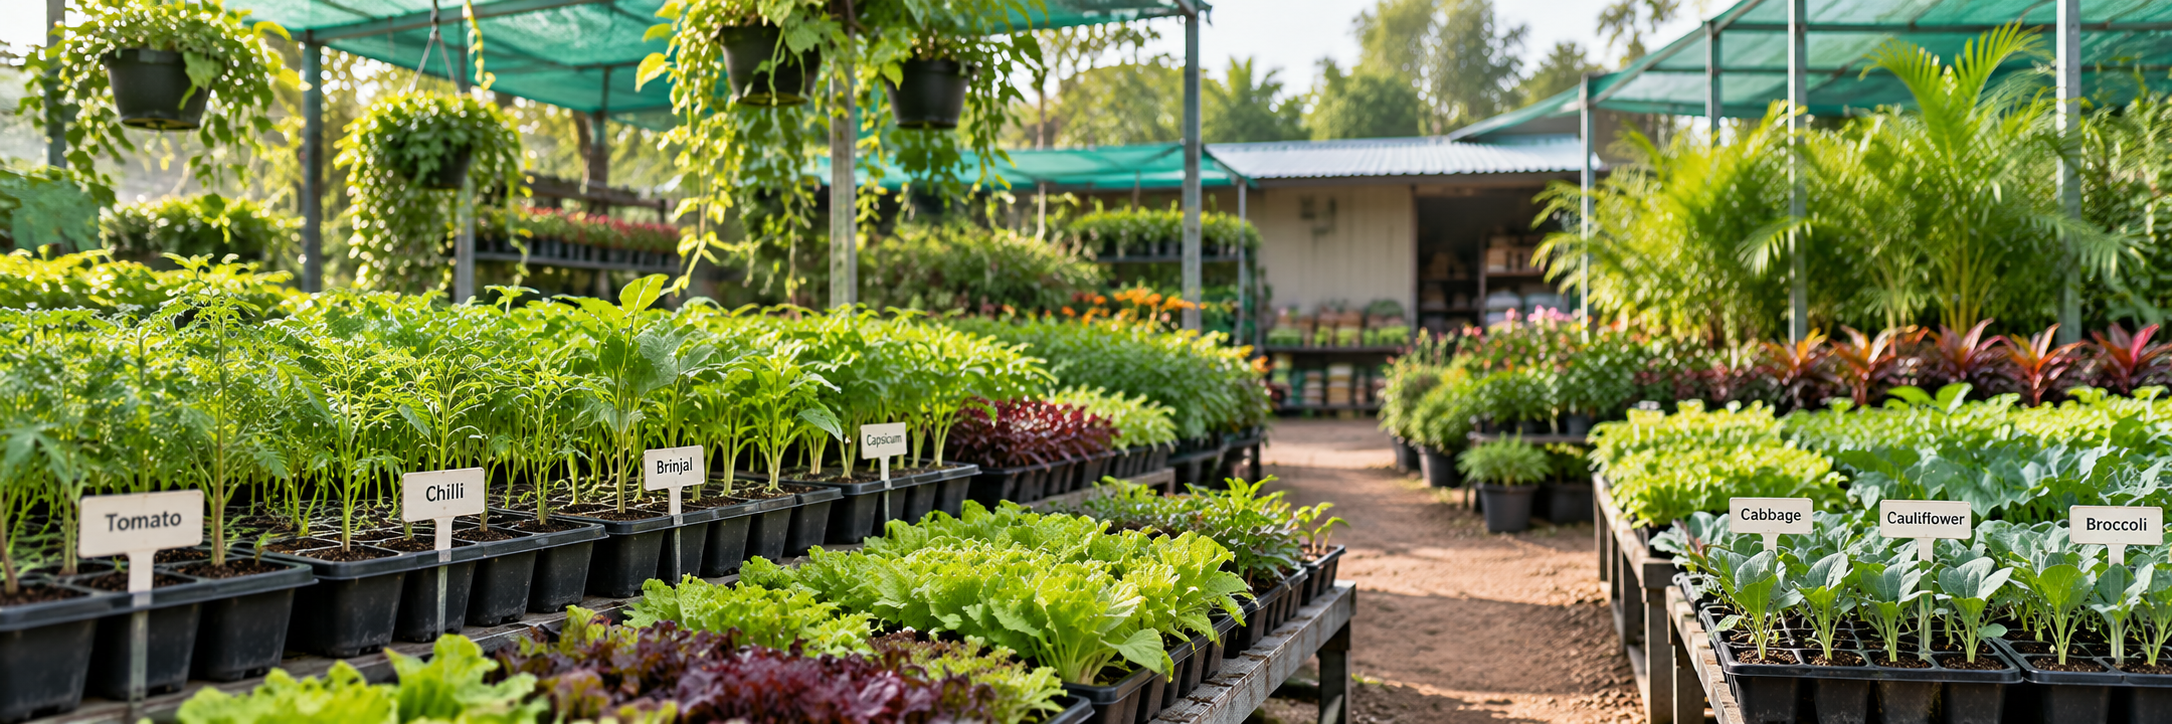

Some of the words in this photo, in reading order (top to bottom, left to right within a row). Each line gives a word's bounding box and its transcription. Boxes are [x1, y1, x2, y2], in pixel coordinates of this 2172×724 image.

[656, 456, 693, 475] Brinjal
[425, 482, 465, 503] Chilli
[104, 510, 182, 533] Tomato
[1740, 507, 1803, 525] Cabbage
[2085, 516, 2148, 533] Broccoli
